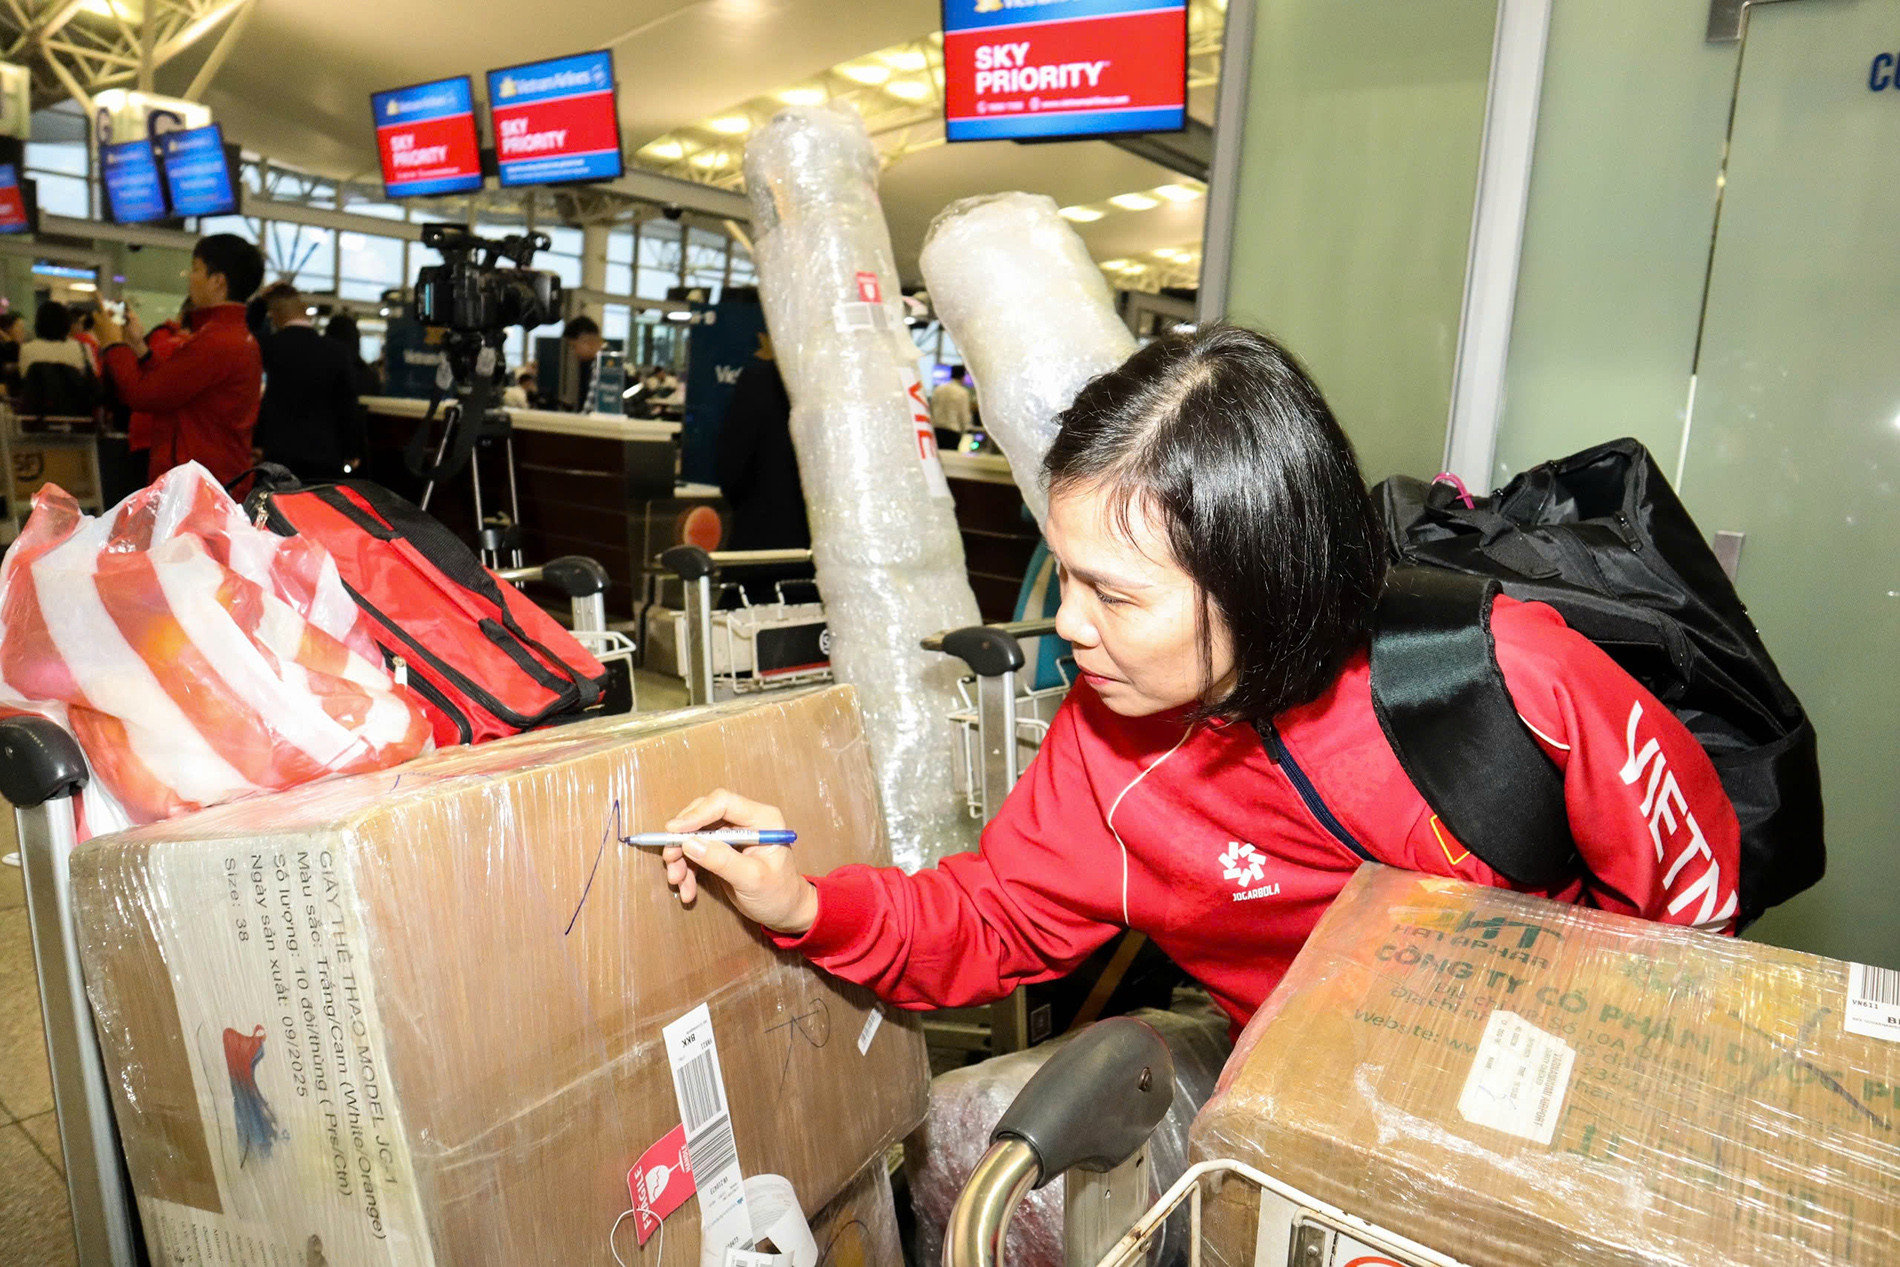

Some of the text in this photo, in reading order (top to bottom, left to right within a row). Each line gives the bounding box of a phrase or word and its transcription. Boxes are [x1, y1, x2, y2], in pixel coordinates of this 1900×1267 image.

[974, 42, 1030, 70] SKY
[974, 60, 1104, 94] PRIORITY
[1868, 52, 1900, 92] C
[390, 134, 415, 151] SKY
[500, 117, 529, 138] SKY
[501, 130, 568, 154] PRIORITY
[391, 145, 448, 168] PRIORITY
[273, 853, 290, 882] Số
[224, 857, 250, 942] Size: 38
[279, 889, 300, 957] lượng:
[250, 854, 268, 909] Ngày
[261, 914, 276, 951] sản
[281, 1016, 309, 1097] 09/2025
[295, 966, 309, 990] 10
[1374, 943, 1474, 981] CÔNG
[1485, 968, 1531, 995] TY
[1887, 1015, 1900, 1027] B
[297, 851, 313, 897] Màu
[305, 904, 323, 948] sắc:
[339, 1081, 387, 1239] (White/Orange)
[300, 997, 329, 1091] đôi/thùng
[343, 970, 366, 1037] THAO
[357, 1045, 385, 1128] MODEL
[1586, 1029, 1627, 1052] 10A
